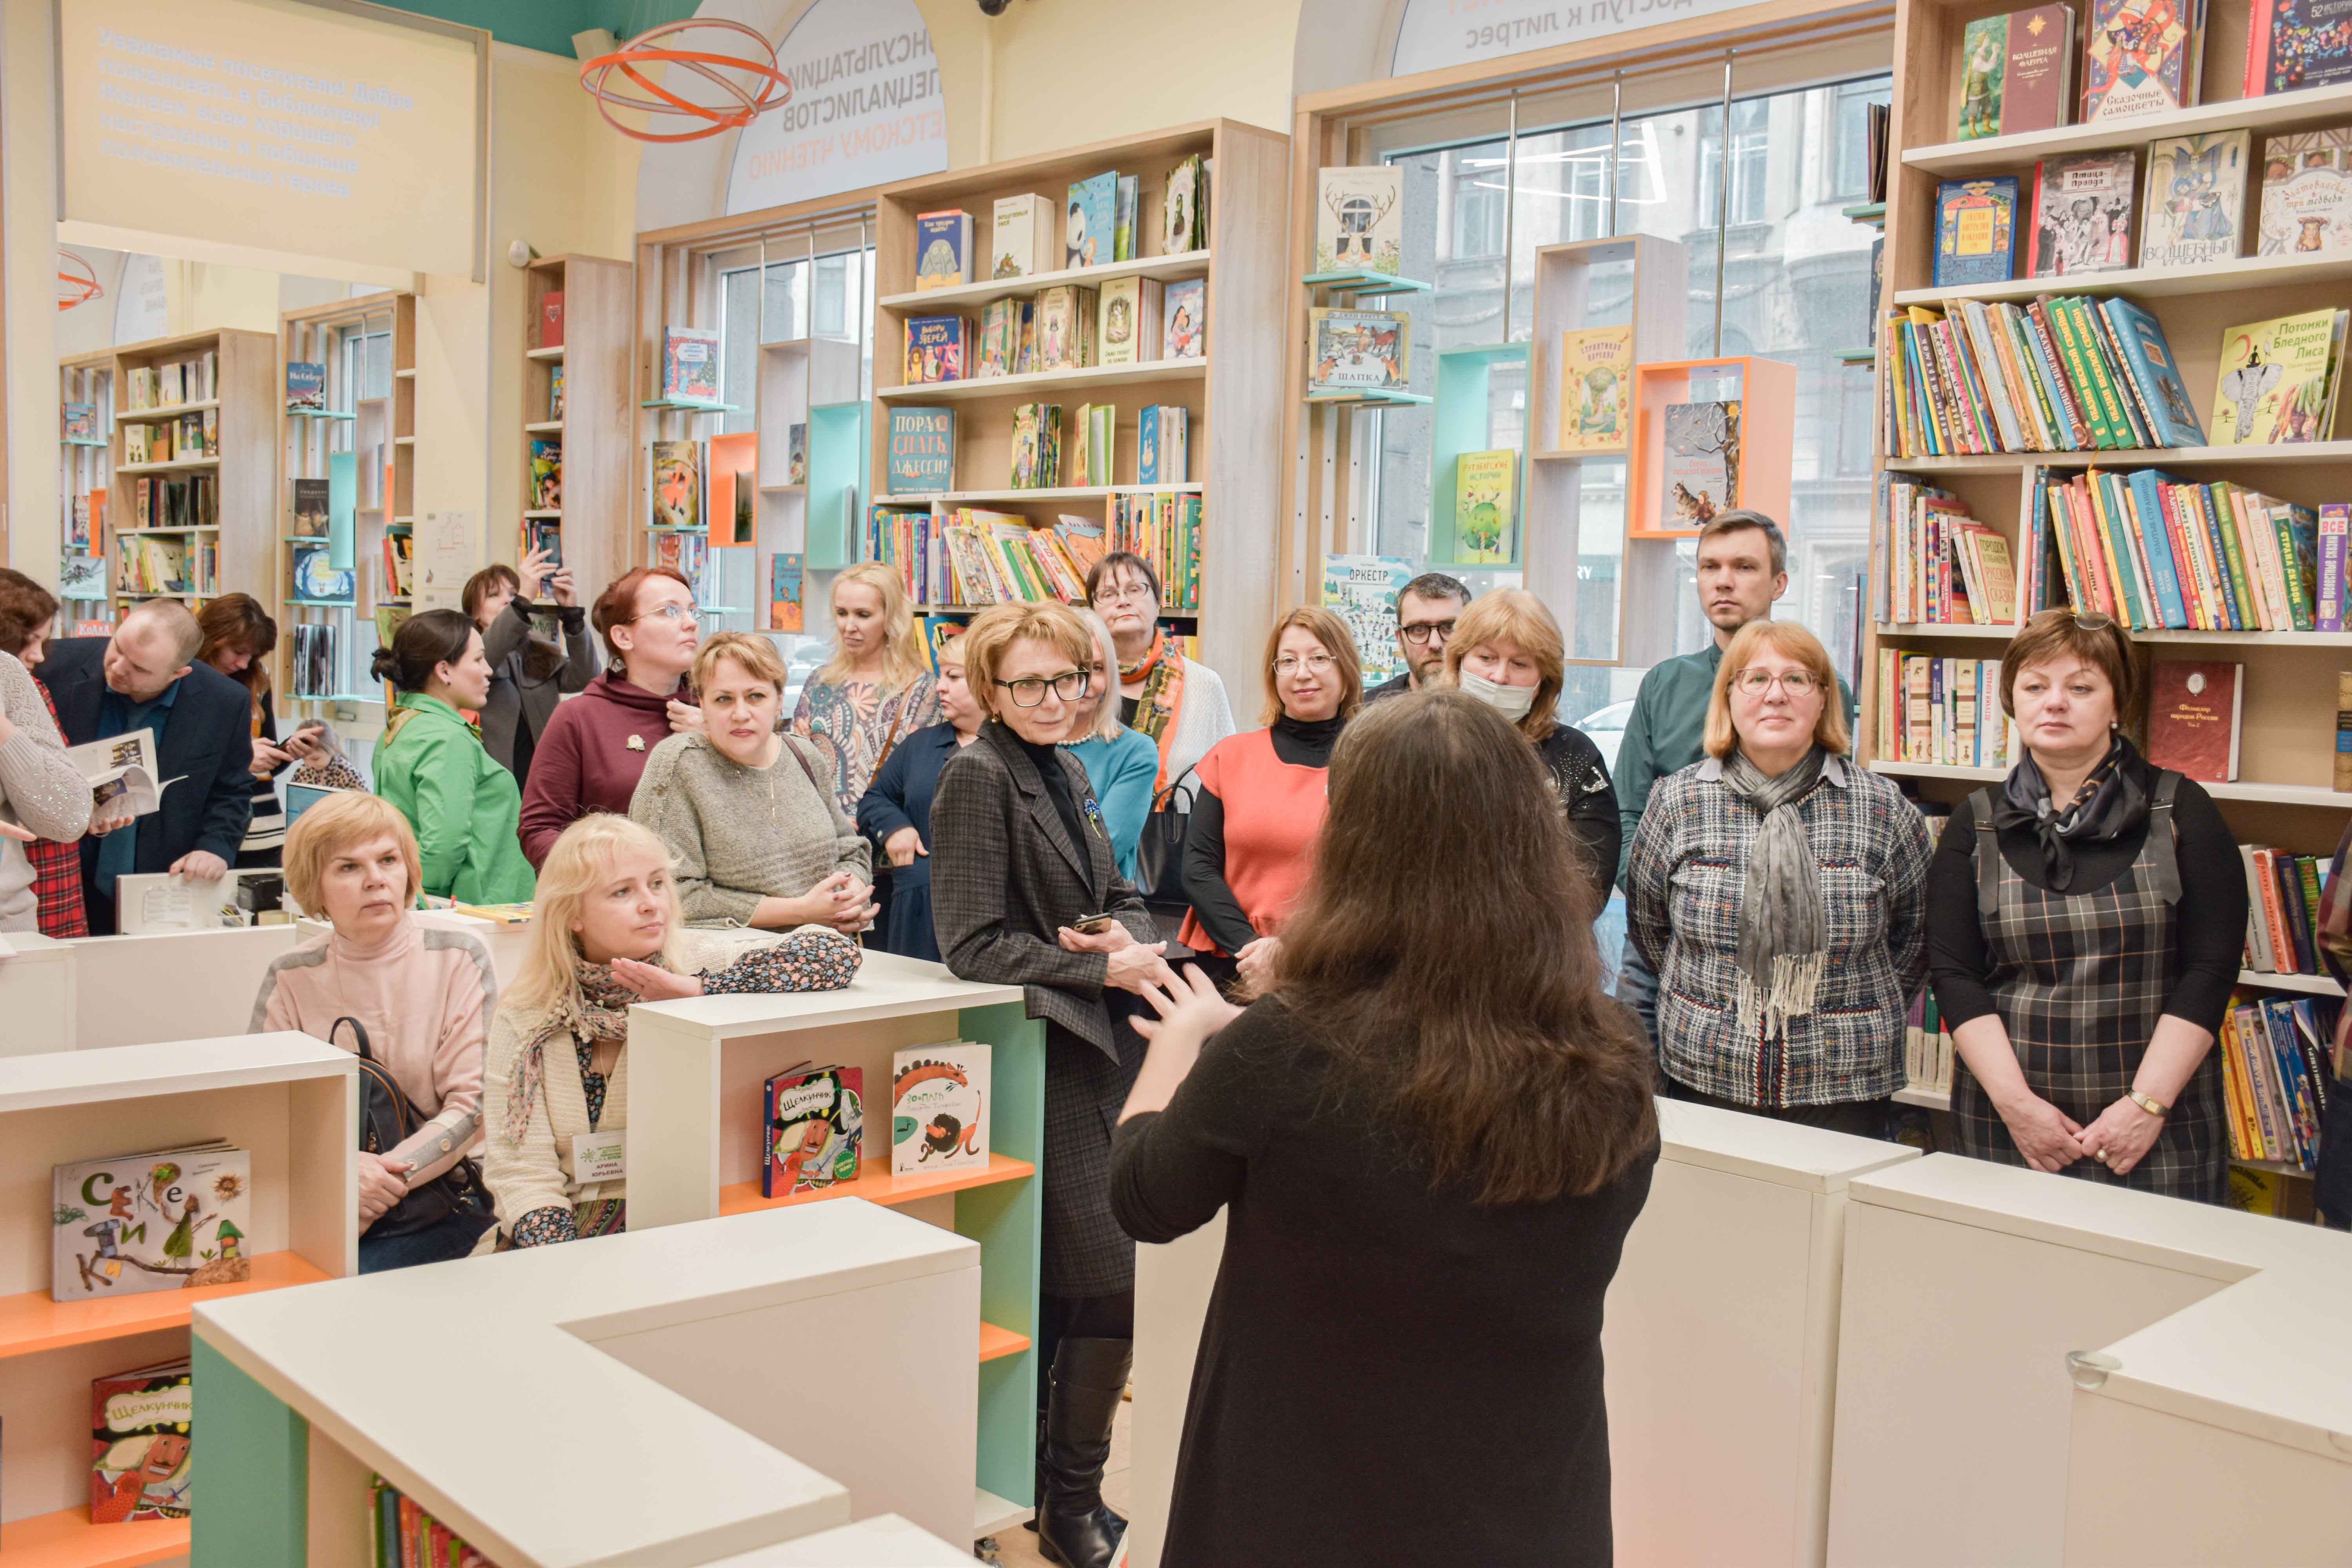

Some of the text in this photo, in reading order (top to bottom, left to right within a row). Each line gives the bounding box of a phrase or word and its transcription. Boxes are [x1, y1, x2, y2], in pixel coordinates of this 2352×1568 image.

[2311, 5, 2323, 18] 52
[2012, 47, 2058, 61] ВОЛШЕБНАЯ
[99, 57, 380, 131] пожаловать в библиотеку!
[352, 82, 414, 111] Добро
[2106, 89, 2162, 105] Сказочные
[98, 81, 355, 149] Желаем всем хорошего
[2103, 98, 2165, 116] самоцветы
[100, 112, 358, 174] настроения и побольше
[100, 138, 349, 198] положительных героев
[2282, 179, 2347, 200] Златовласка
[2306, 194, 2343, 206] медведя
[2145, 238, 2234, 260] ВОЛШЕБНЫЙ
[2055, 307, 2074, 348] СЕМЕЙКИ
[2072, 308, 2092, 348] СЕМЕЙКИ
[2279, 319, 2329, 336] Потомки
[2274, 333, 2327, 349] Бледного
[2295, 347, 2325, 359] Лиса
[1338, 372, 1380, 382] ШАПКА
[2038, 328, 2077, 425] СКАЗКИ ДЛЯ МАЛЫШЕЙ
[2083, 389, 2099, 421] СКАЗКИ
[2102, 388, 2120, 422] СКАЗКИ
[895, 416, 934, 433] ПОРА
[893, 436, 947, 455] СПАТЬ
[891, 459, 947, 475] ДЖЕССИ!
[2205, 499, 2216, 530] СКАЗКИ
[2322, 521, 2345, 533] ВСЕ
[2325, 535, 2339, 559] сказки
[1349, 569, 1388, 581] ОРКЕСТР
[2281, 531, 2301, 604] СТРАНА СКАЗОК
[2221, 573, 2233, 605] ЛУЧШИЕ
[2263, 561, 2276, 598] СКАЗКИ
[1984, 668, 1993, 721] ЛЕТУЧИЙ КОРАБЛЬ
[2179, 704, 2211, 713] Фольклор
[592, 1169, 624, 1177] ЮРЬЕВНА
